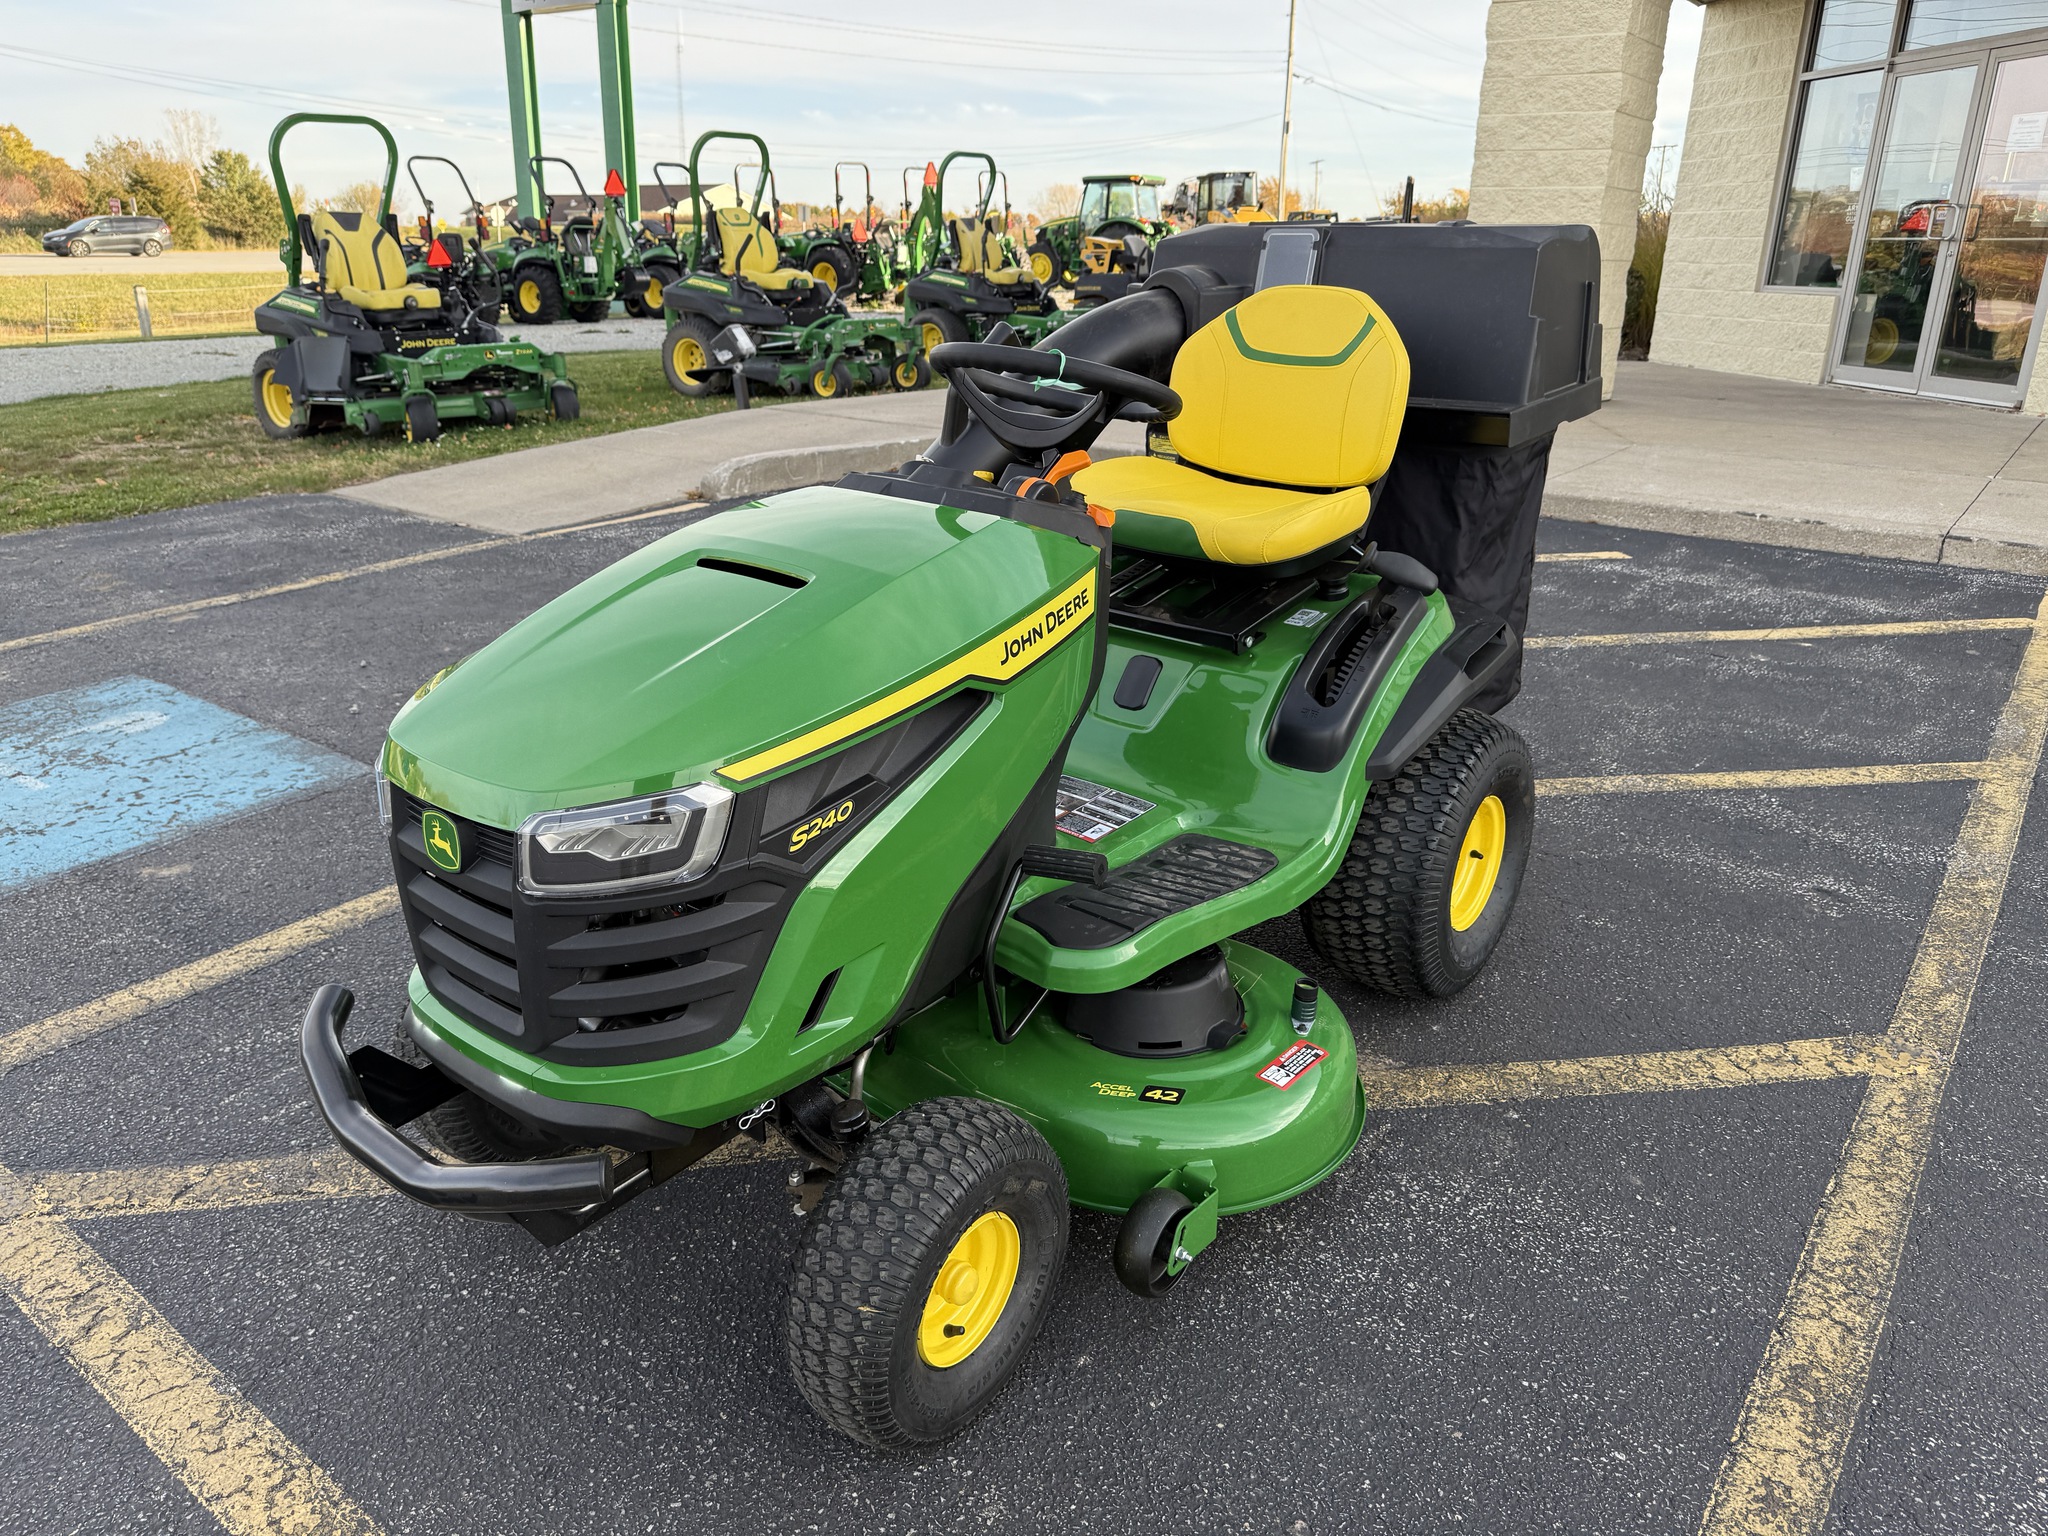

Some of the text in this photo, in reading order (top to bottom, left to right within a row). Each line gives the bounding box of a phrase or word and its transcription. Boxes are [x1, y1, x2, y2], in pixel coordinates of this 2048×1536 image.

[401, 338, 456, 349] JOHN DEERE
[1000, 587, 1089, 666] JOHN DEERE
[789, 800, 854, 853] S240
[1090, 1081, 1134, 1092] ACCEL
[1098, 1088, 1137, 1098] DEEP
[1145, 1089, 1179, 1102] 42
[1029, 1262, 1050, 1313] TURF
